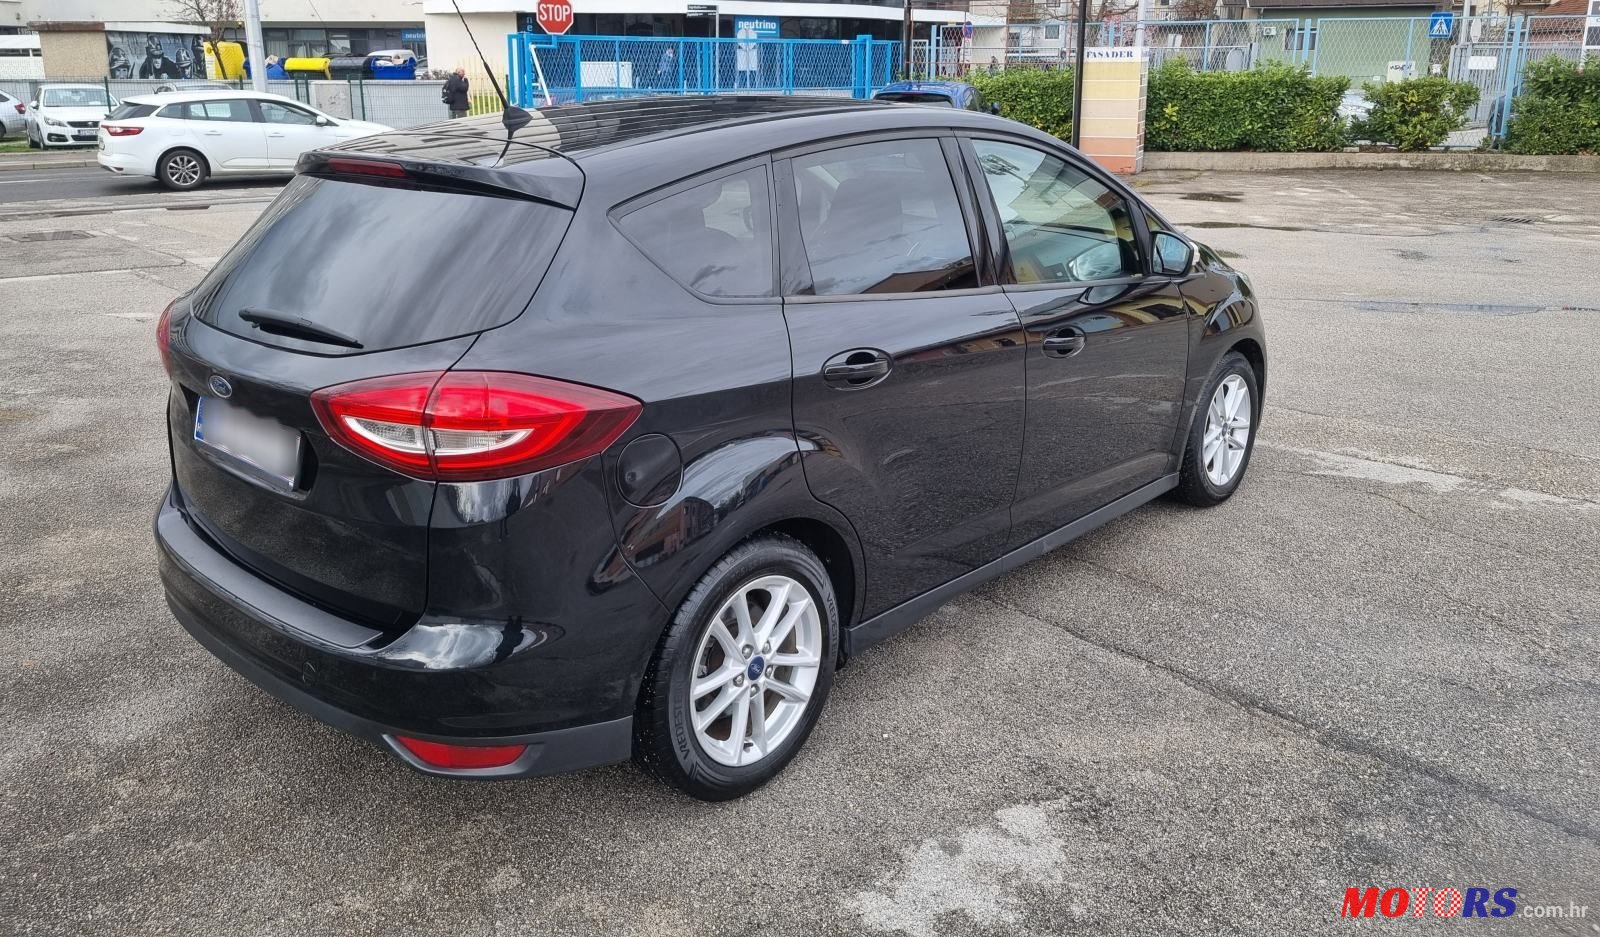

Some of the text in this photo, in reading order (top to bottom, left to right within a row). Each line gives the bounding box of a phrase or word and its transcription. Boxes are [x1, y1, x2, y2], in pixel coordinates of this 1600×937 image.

[539, 4, 571, 22] STOP
[738, 19, 777, 30] neutrino
[673, 686, 690, 761] VREDESTE
